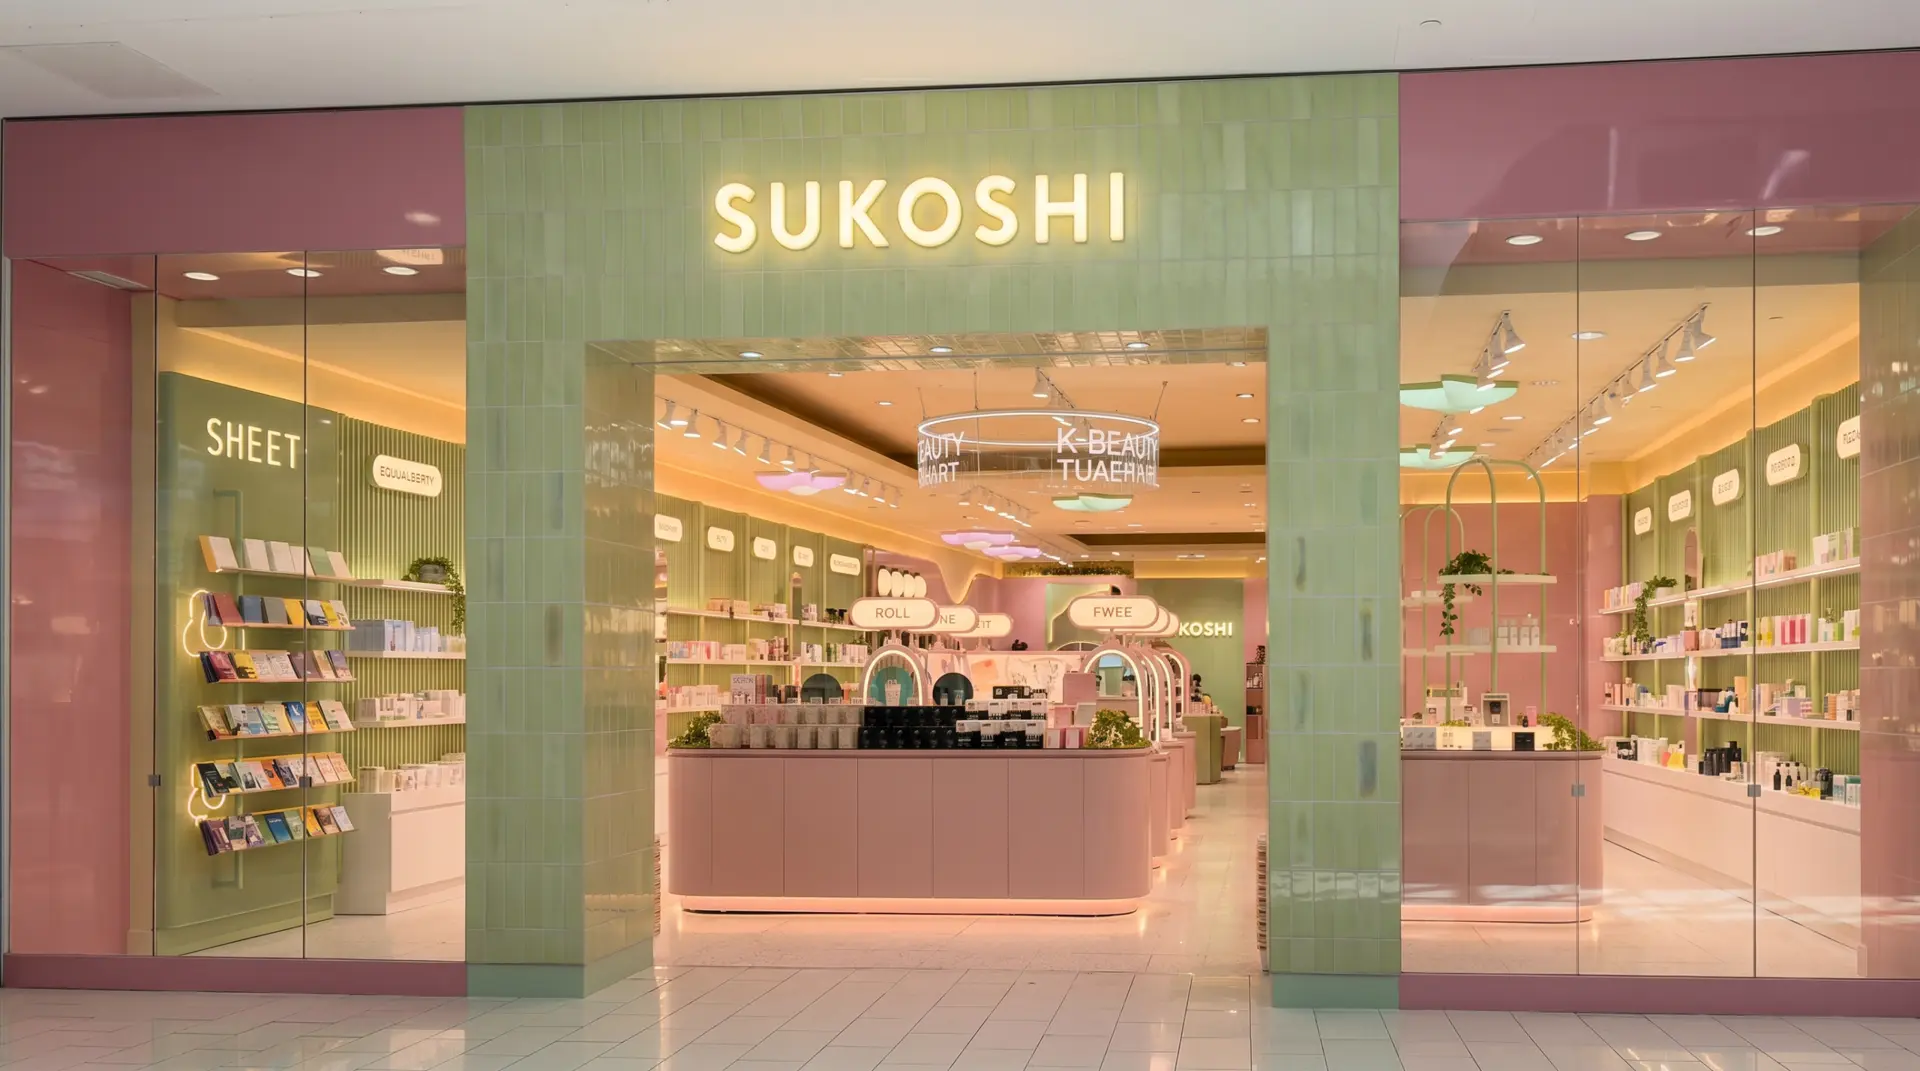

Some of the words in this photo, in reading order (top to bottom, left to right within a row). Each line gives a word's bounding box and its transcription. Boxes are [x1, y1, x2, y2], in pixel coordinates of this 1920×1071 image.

[714, 171, 1124, 253] SUKOSHI
[206, 417, 301, 469] SHEET
[875, 607, 911, 619] ROLL
[1093, 606, 1133, 618] FWEE
[1178, 622, 1233, 637] KOSHI
